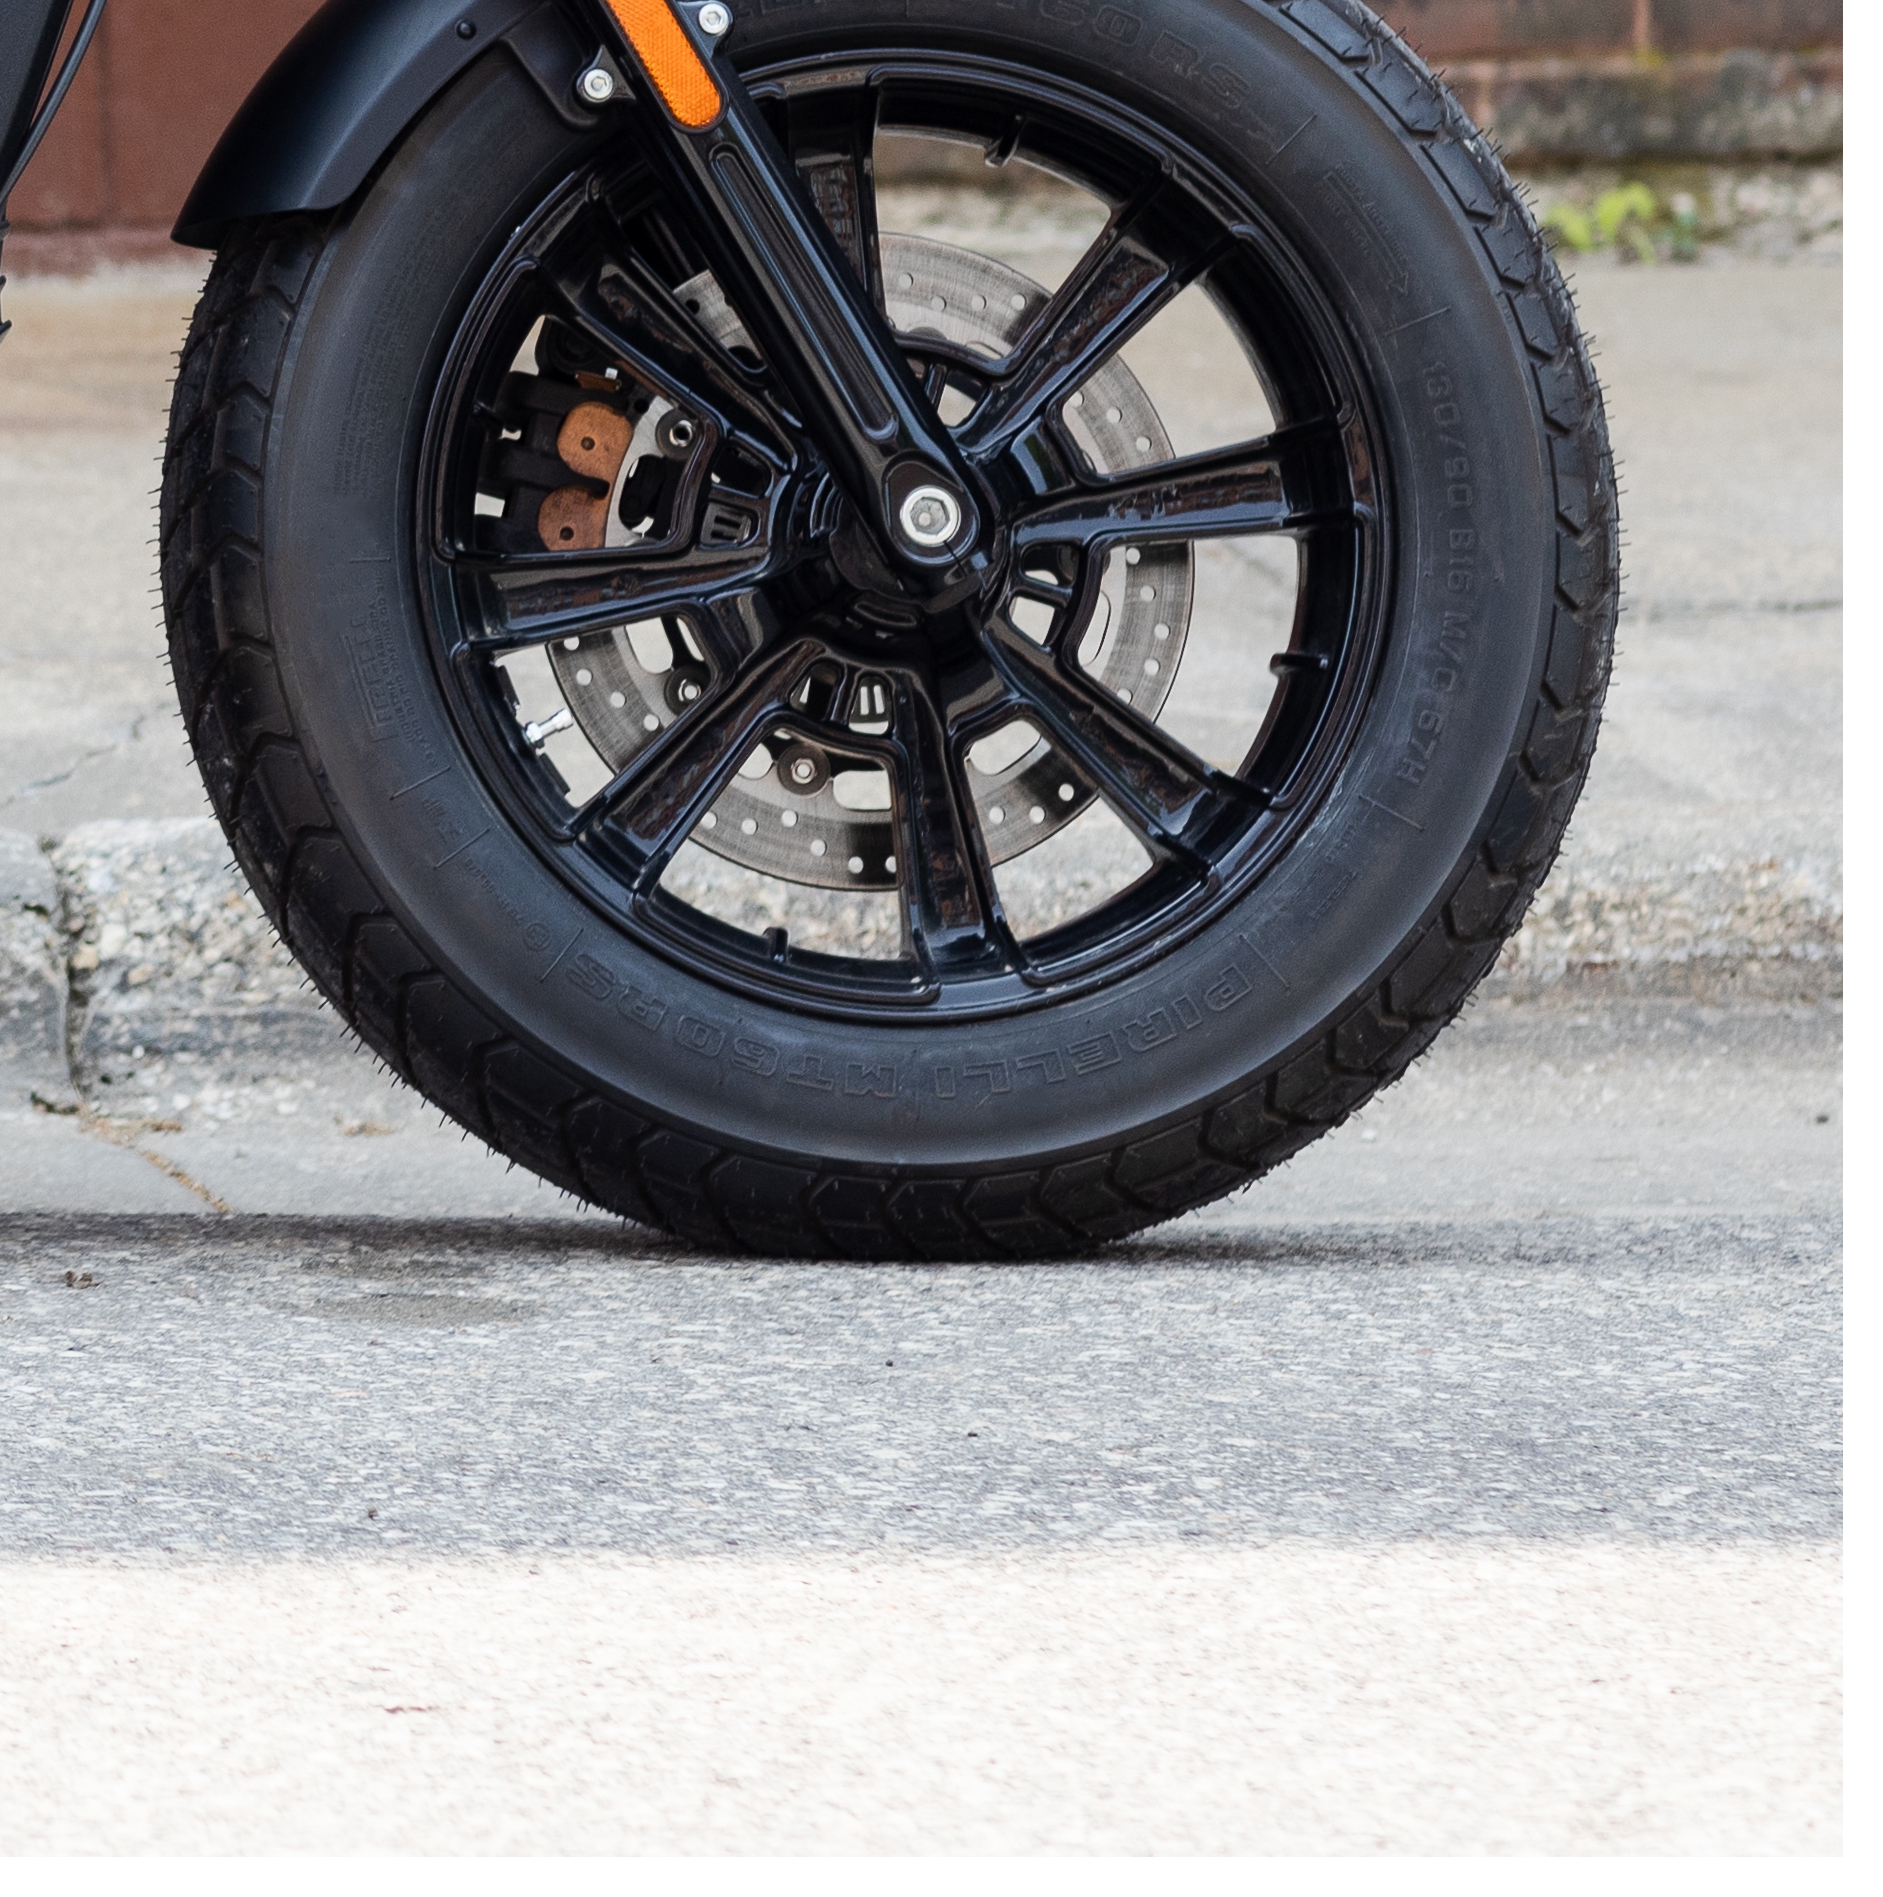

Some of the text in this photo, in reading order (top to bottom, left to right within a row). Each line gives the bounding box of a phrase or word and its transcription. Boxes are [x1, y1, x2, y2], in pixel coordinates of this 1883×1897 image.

[1419, 358, 1473, 509] 130/90
[1446, 527, 1474, 595] B16
[1394, 705, 1444, 788] 67H
[934, 961, 1254, 1100] PIRELLI
